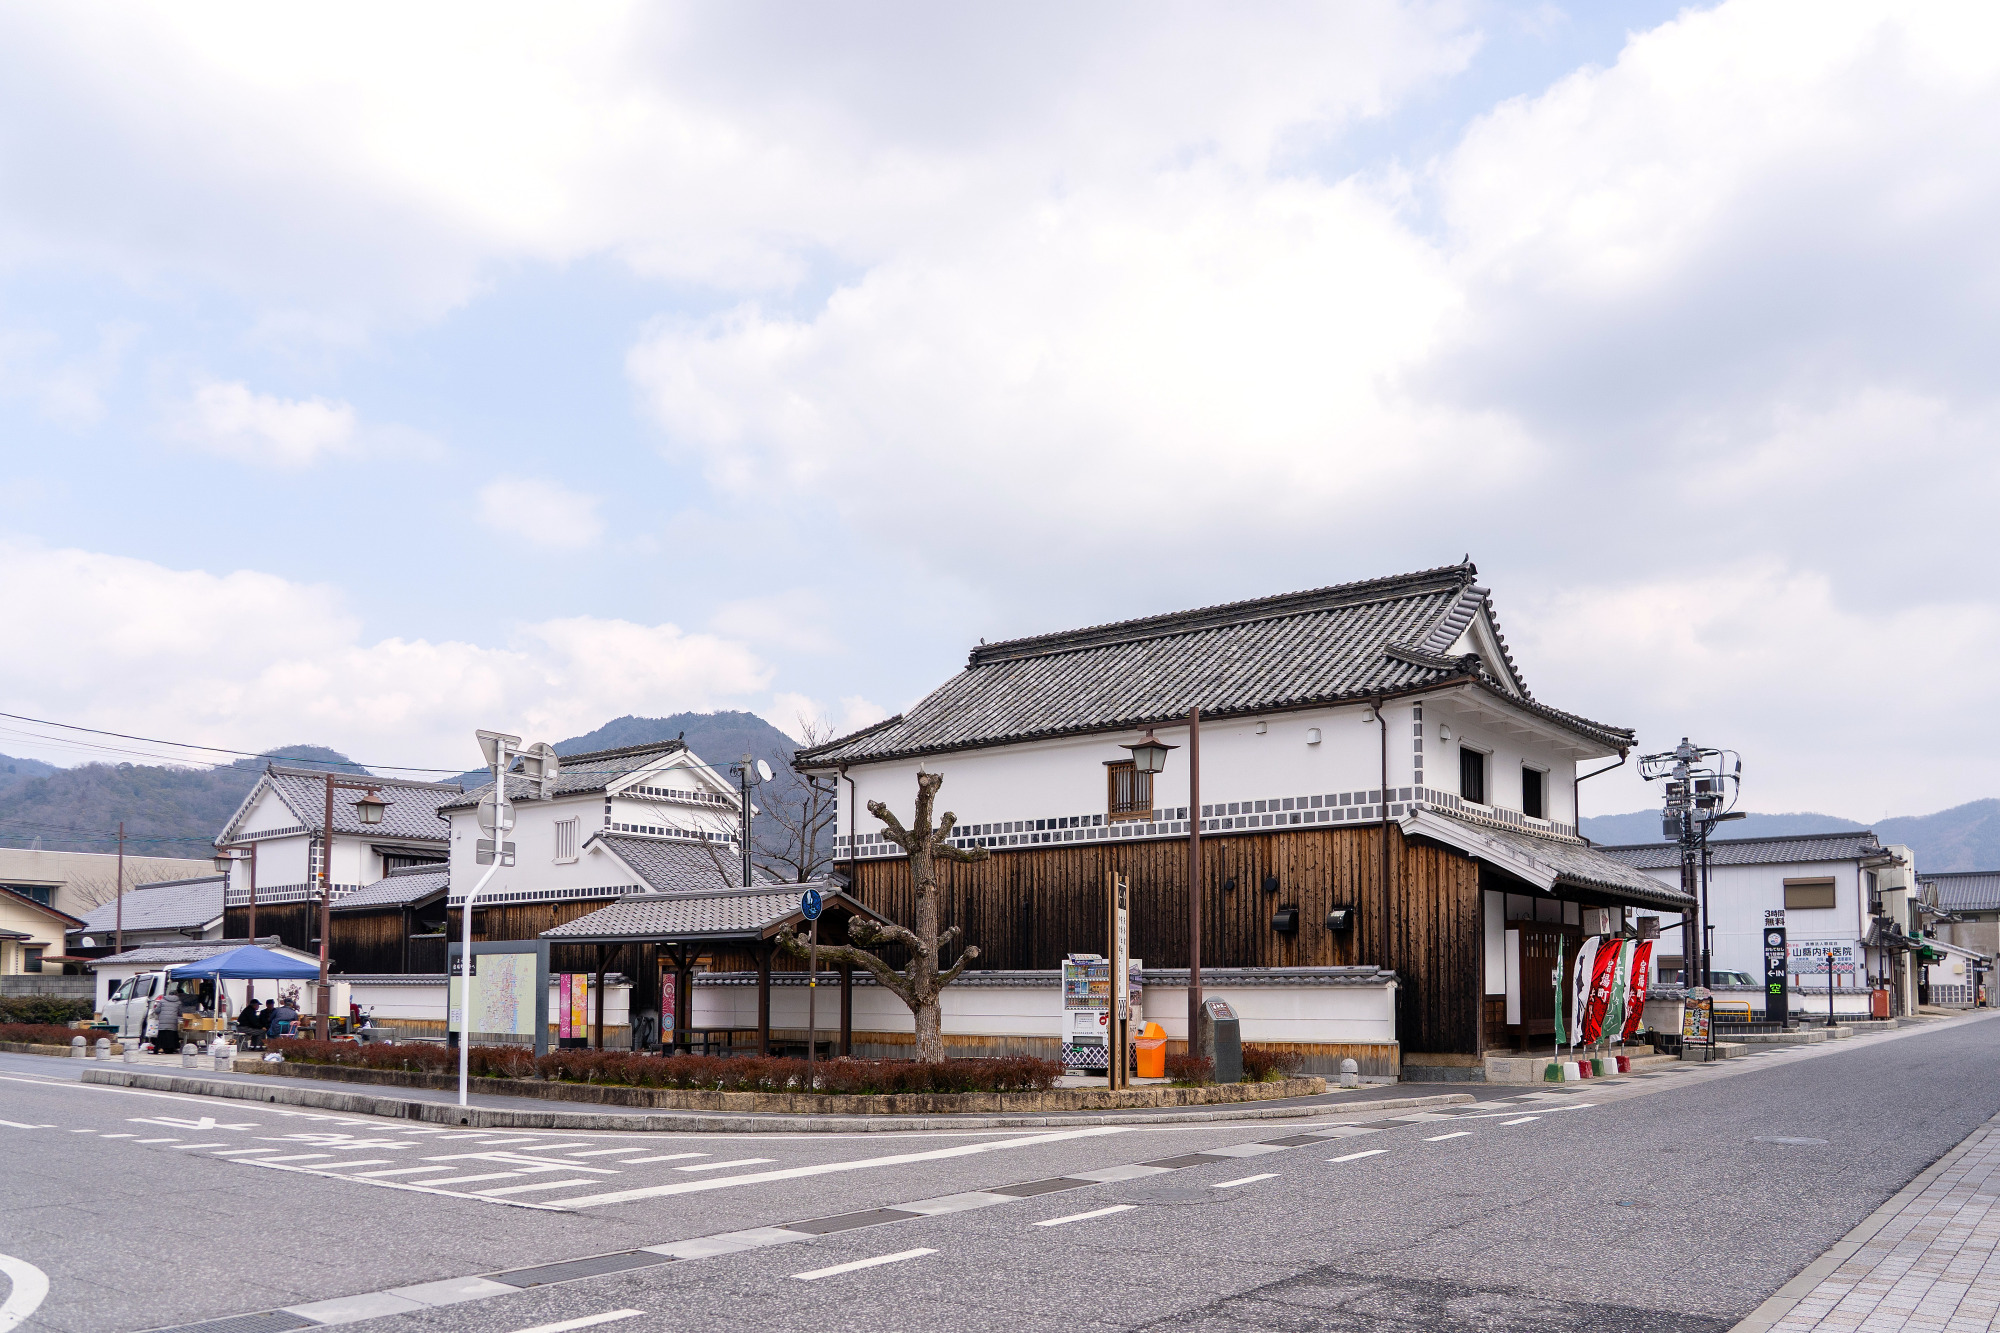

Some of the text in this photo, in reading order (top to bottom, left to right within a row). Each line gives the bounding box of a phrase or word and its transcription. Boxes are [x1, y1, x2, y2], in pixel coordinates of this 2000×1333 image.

[1764, 909, 1785, 918] 3時間
[1765, 917, 1785, 926] 無料
[1771, 959, 1780, 970] P
[1769, 983, 1781, 994] 空
